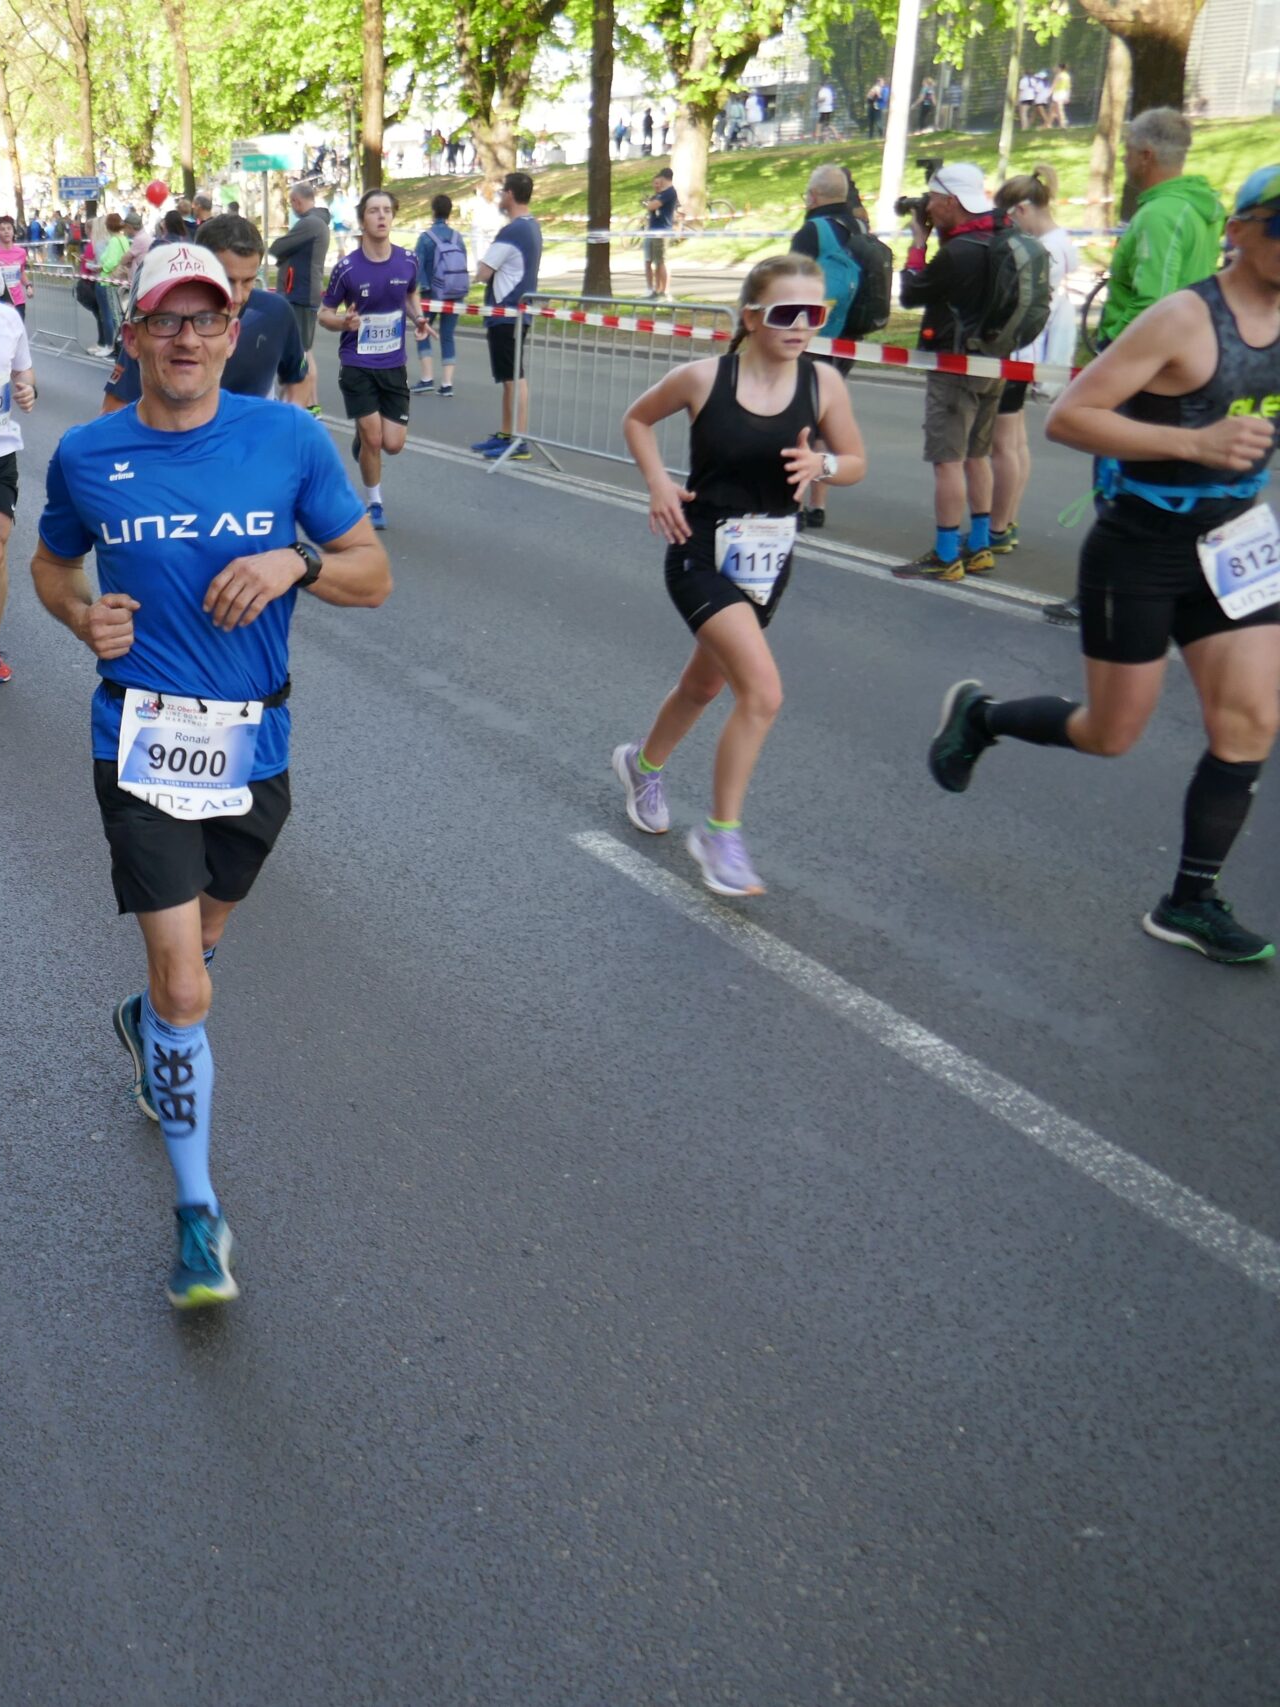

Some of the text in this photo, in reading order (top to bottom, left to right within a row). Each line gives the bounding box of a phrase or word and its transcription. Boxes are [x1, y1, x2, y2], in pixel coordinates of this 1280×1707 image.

[169, 261, 206, 274] ATARI
[365, 327, 397, 339] 13138
[109, 471, 135, 482] erima
[100, 511, 275, 545] LINZ AG
[1229, 538, 1280, 578] 812
[174, 731, 211, 745] Ronald
[148, 743, 227, 777] 9000
